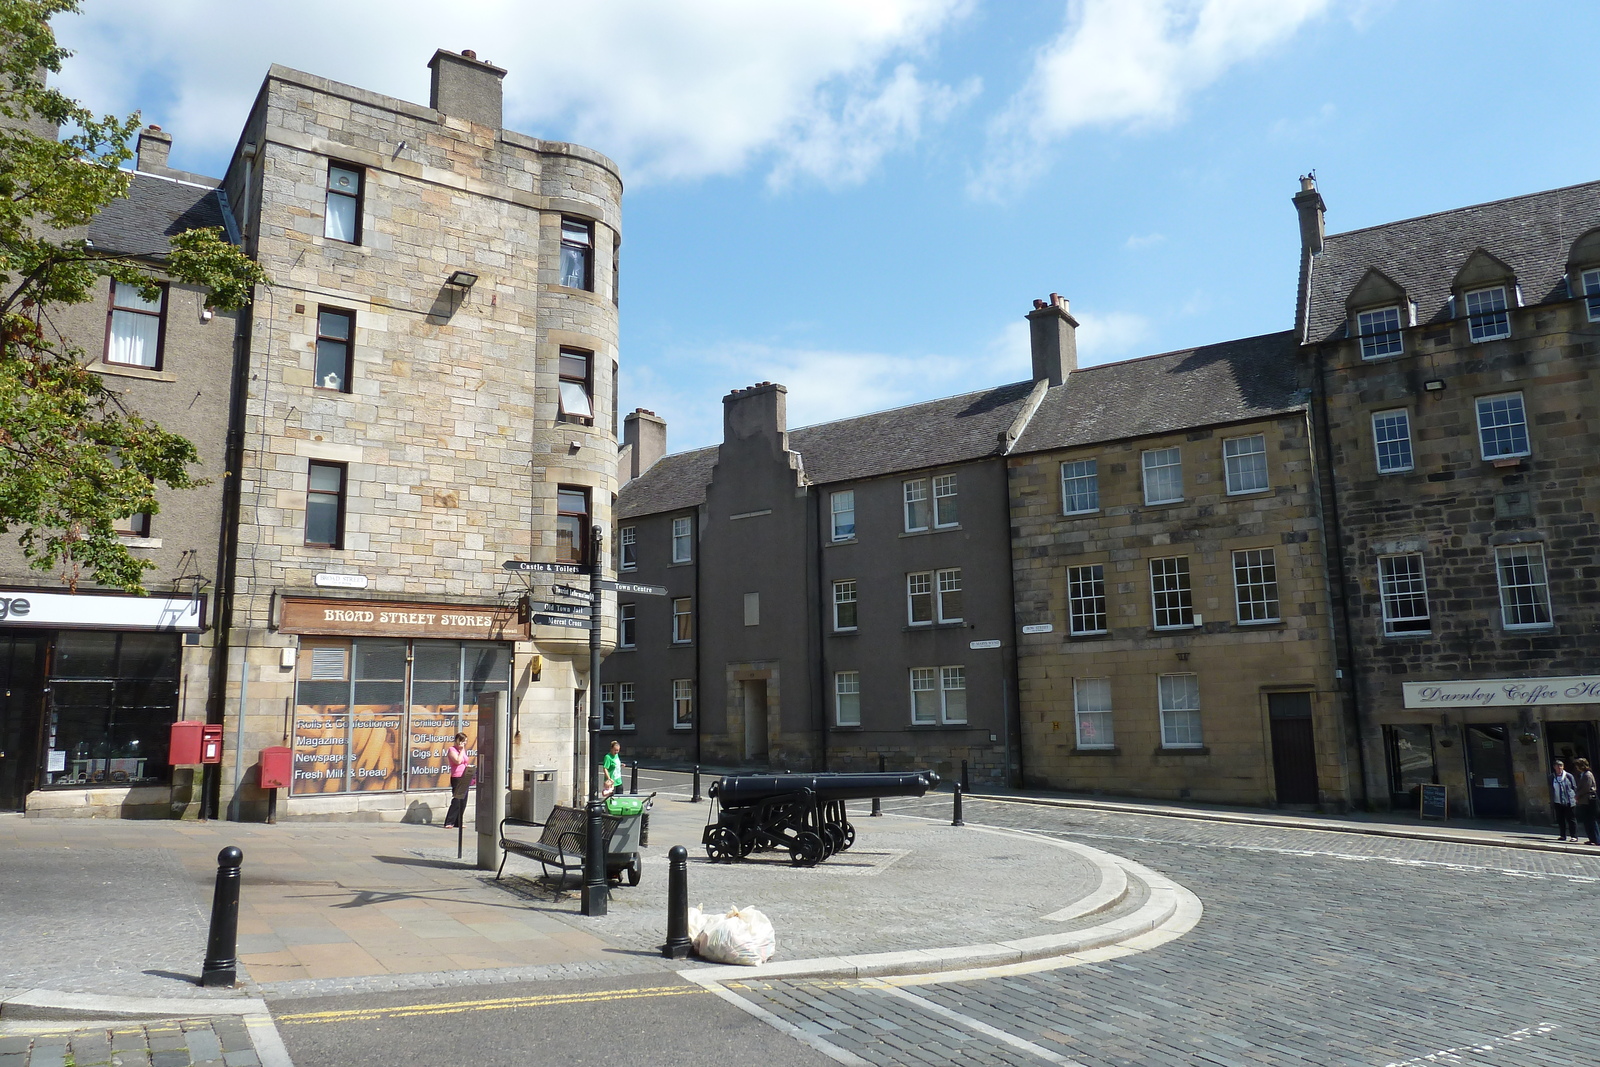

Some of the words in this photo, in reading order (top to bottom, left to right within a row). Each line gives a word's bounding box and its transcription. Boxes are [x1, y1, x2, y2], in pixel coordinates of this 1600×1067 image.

[520, 563, 544, 571] Castle
[555, 565, 580, 573] Toilets
[633, 585, 652, 593] Centre
[573, 606, 583, 614] Jail
[324, 610, 374, 622] BROAD
[380, 612, 436, 625] STREET
[440, 615, 492, 627] STORES
[548, 617, 566, 625] Mercat
[1418, 686, 1495, 705] Darnley
[1502, 684, 1558, 704] Coffee
[297, 720, 321, 729] Rolls
[325, 720, 333, 728] &
[335, 719, 400, 729] Cofectionery
[414, 719, 441, 727] Chilled
[444, 719, 470, 727] Driks
[296, 737, 349, 748] Magazines
[413, 734, 455, 743] Off-licenc
[296, 753, 357, 764] Newspapes
[412, 750, 431, 759] Cigs
[434, 749, 440, 757] &
[295, 769, 326, 779] Fresh
[326, 769, 346, 778] Milk
[350, 769, 355, 777] &
[358, 768, 387, 777] Bread
[412, 766, 438, 774] Mobile
